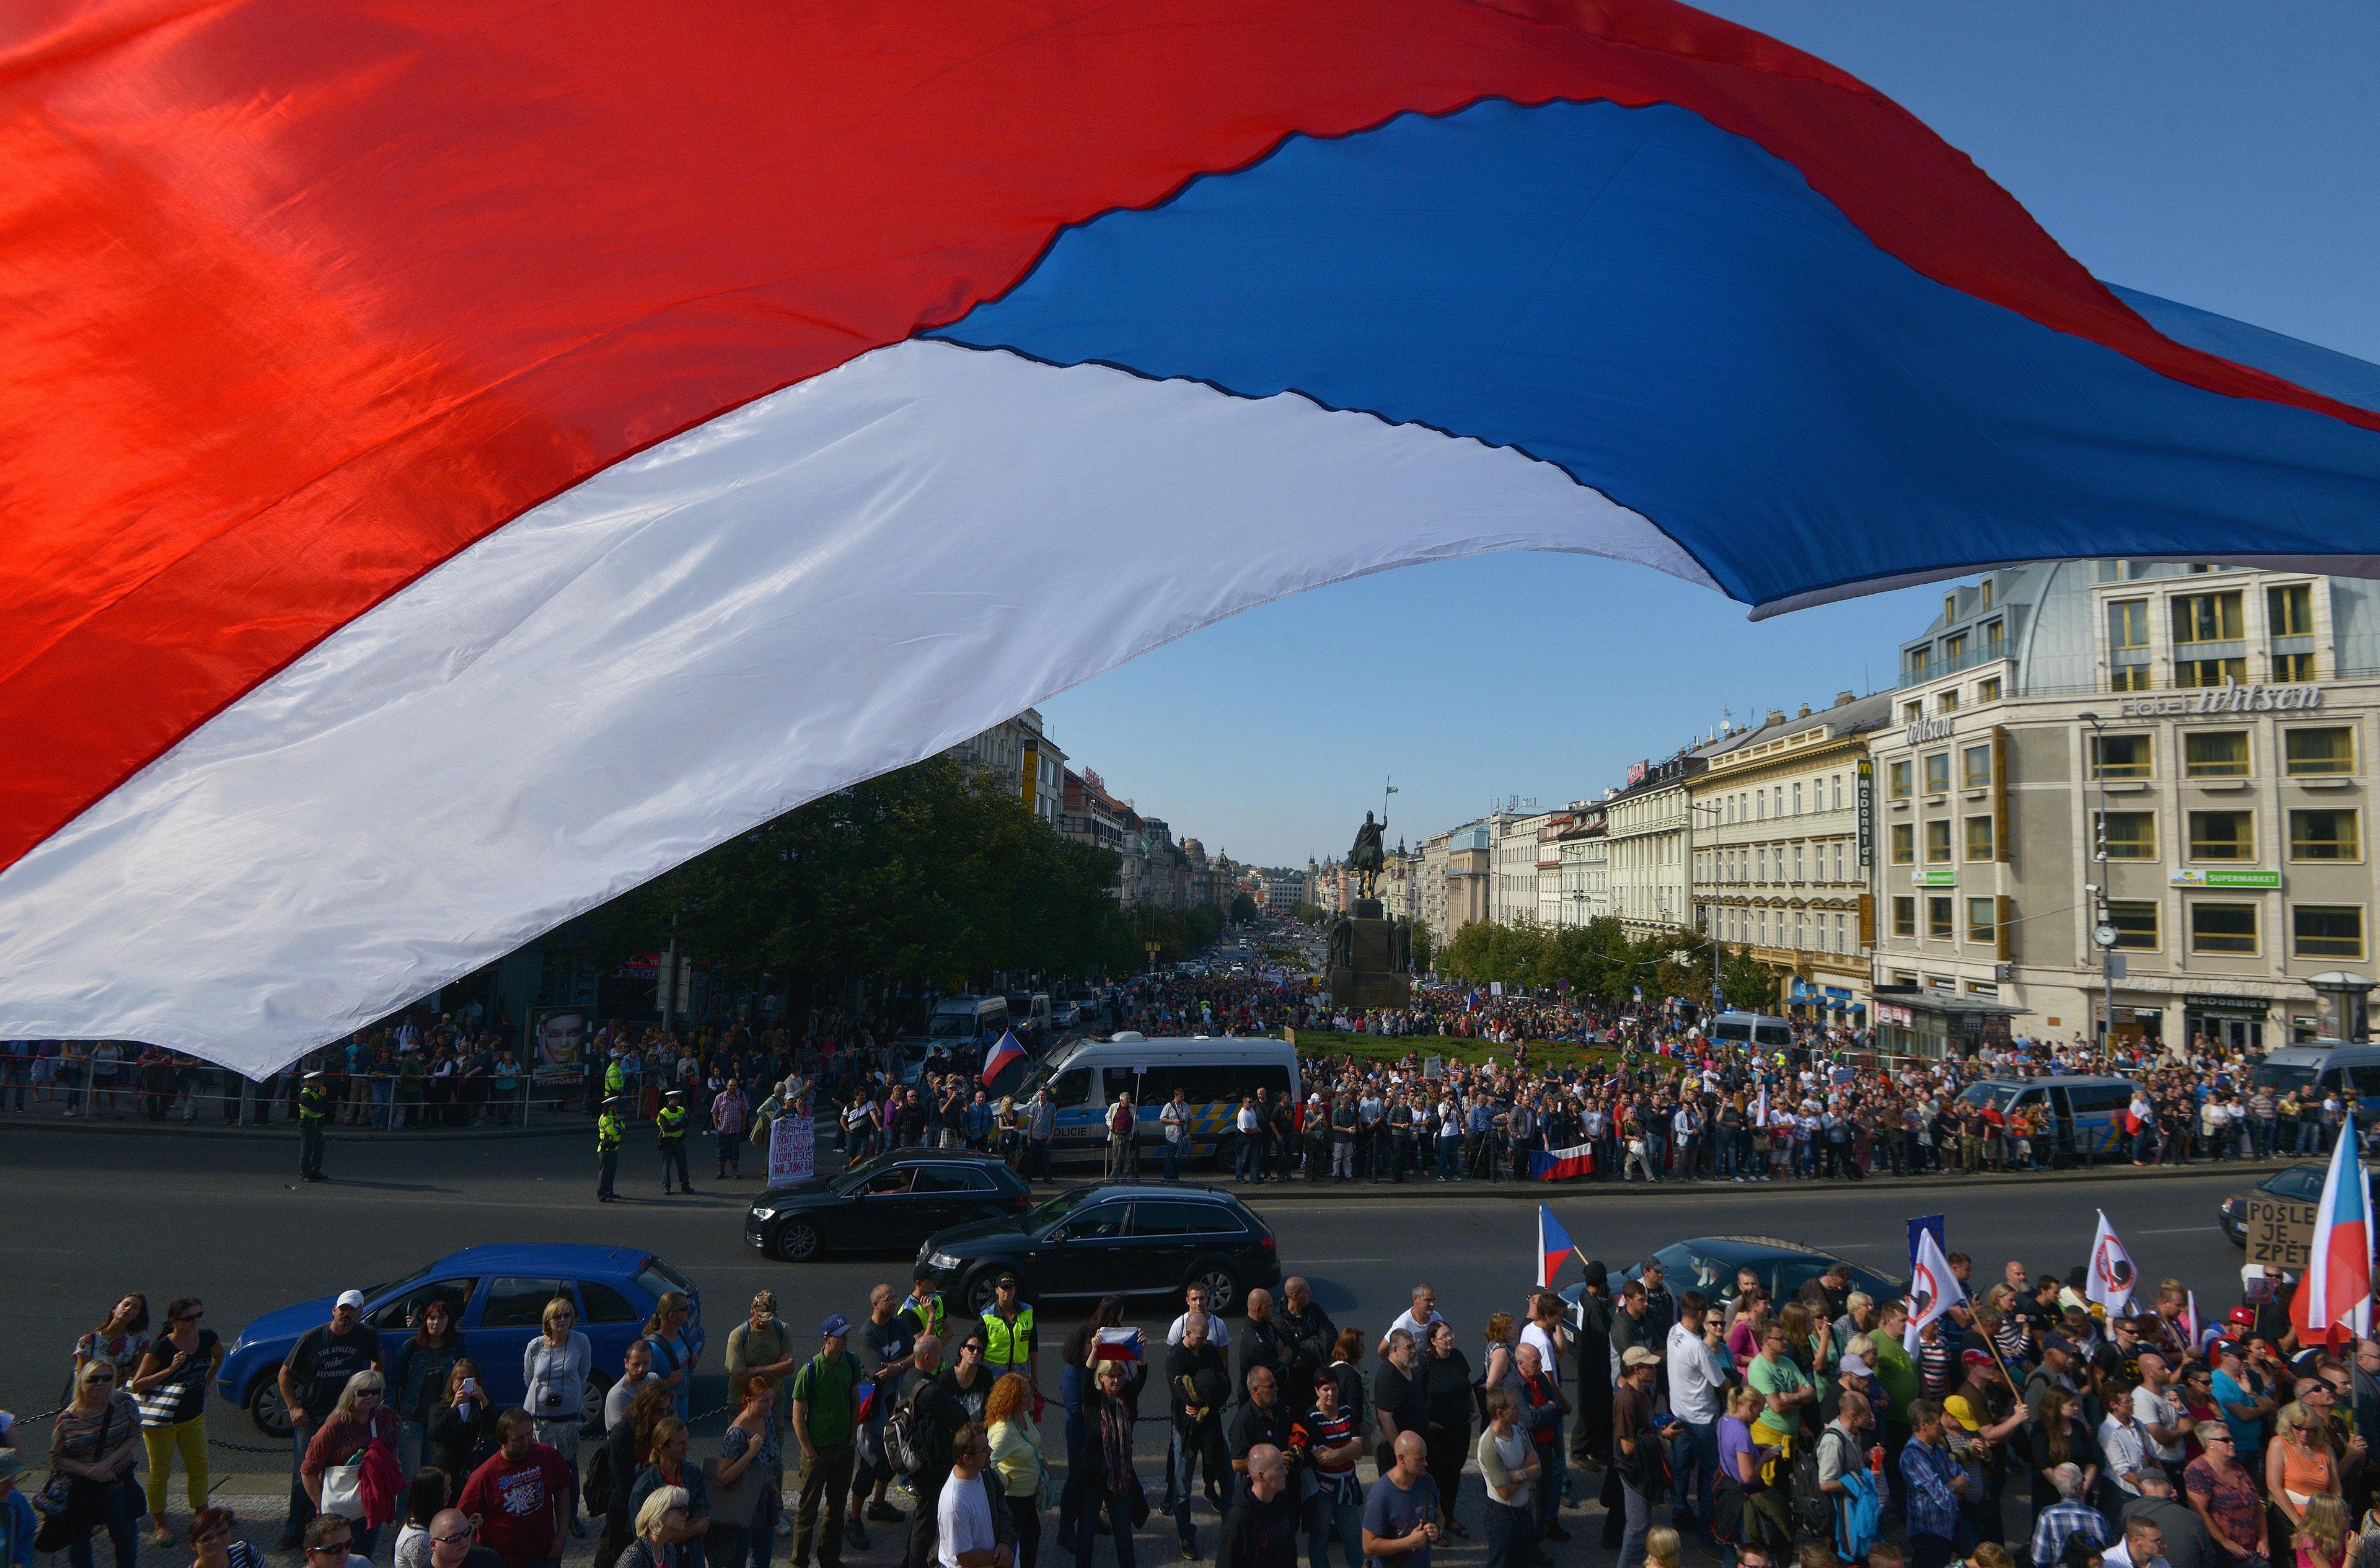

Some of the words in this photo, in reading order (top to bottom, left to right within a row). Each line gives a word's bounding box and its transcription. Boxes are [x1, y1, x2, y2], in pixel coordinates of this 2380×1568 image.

[2118, 692, 2188, 716] Hotel
[1859, 779, 1871, 865] McDonald's
[2208, 874, 2276, 883] SUPERMARKET
[2187, 995, 2268, 1008] McDonald's
[536, 1078, 577, 1087] SEPHORA
[1054, 1127, 1087, 1137] OLICIE
[778, 1143, 793, 1152] THIS
[776, 1152, 791, 1163] LORD
[792, 1151, 813, 1161] JESUS
[787, 1161, 803, 1173] JUDGE
[2249, 1203, 2316, 1225] POŠLE
[2260, 1223, 2288, 1244] JE
[2255, 1240, 2311, 1264] ZPĚT
[317, 1347, 332, 1358] THE
[332, 1346, 358, 1355] ATHLETIC
[316, 1368, 354, 1378] DEPARTMENT
